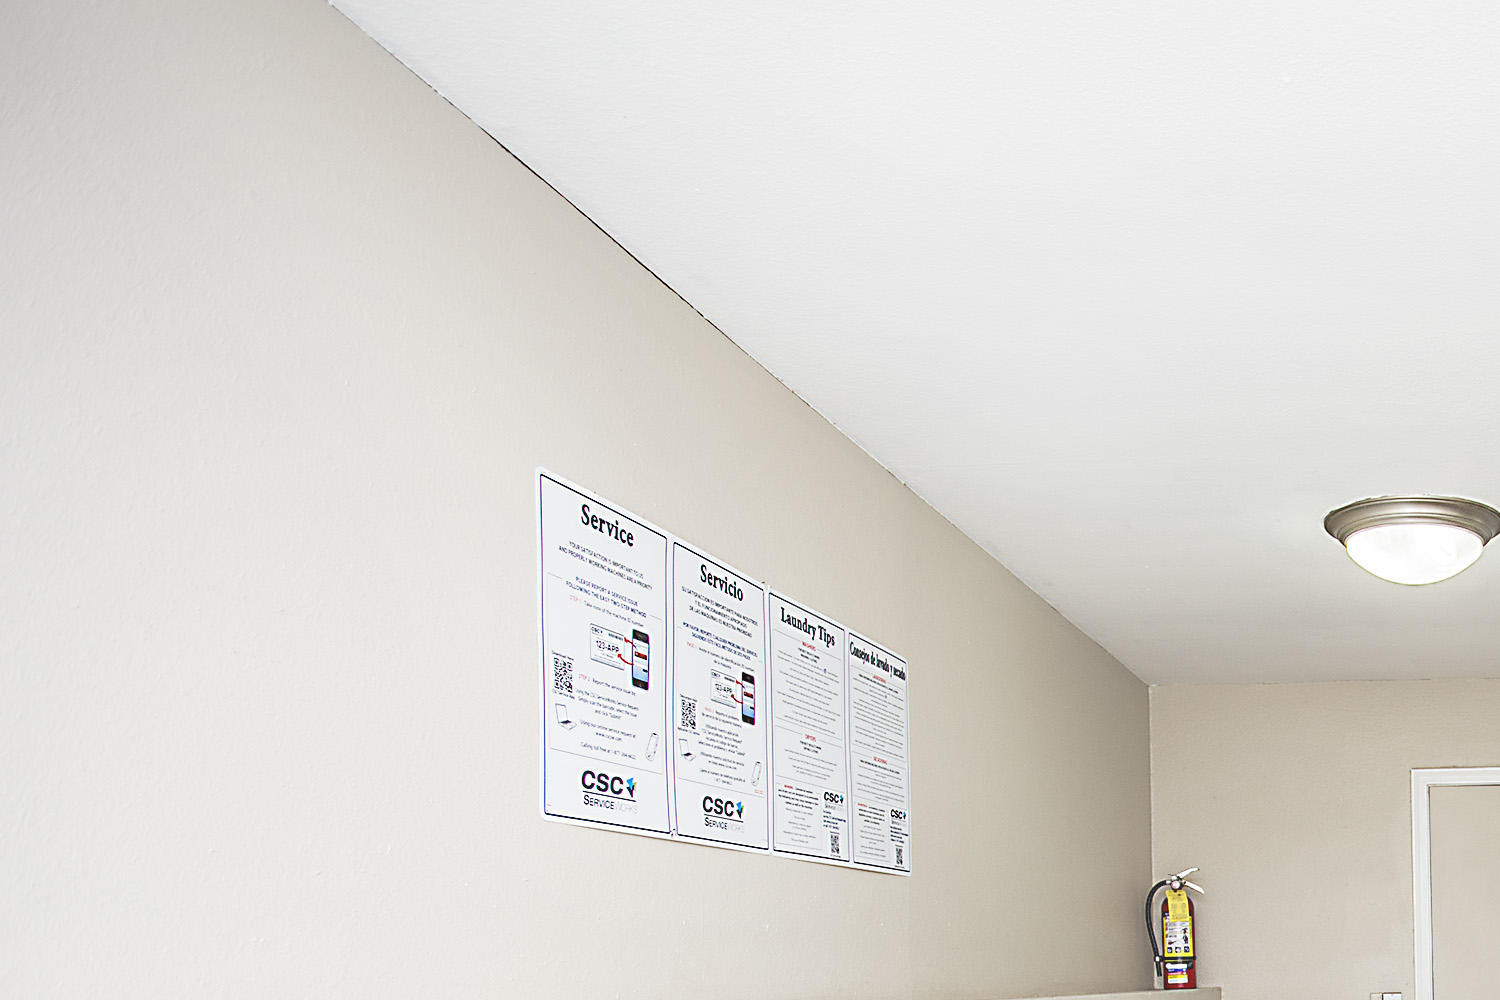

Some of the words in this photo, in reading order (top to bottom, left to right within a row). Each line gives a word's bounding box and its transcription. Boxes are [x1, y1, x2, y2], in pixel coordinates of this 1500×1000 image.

[581, 503, 635, 548] Service
[700, 564, 744, 601] Servicio
[780, 606, 817, 641] Laundry
[817, 625, 836, 649] Tips
[581, 770, 624, 795] CSC
[702, 796, 735, 817] CSC
[824, 791, 840, 804] CSC
[890, 808, 903, 820] CSC
